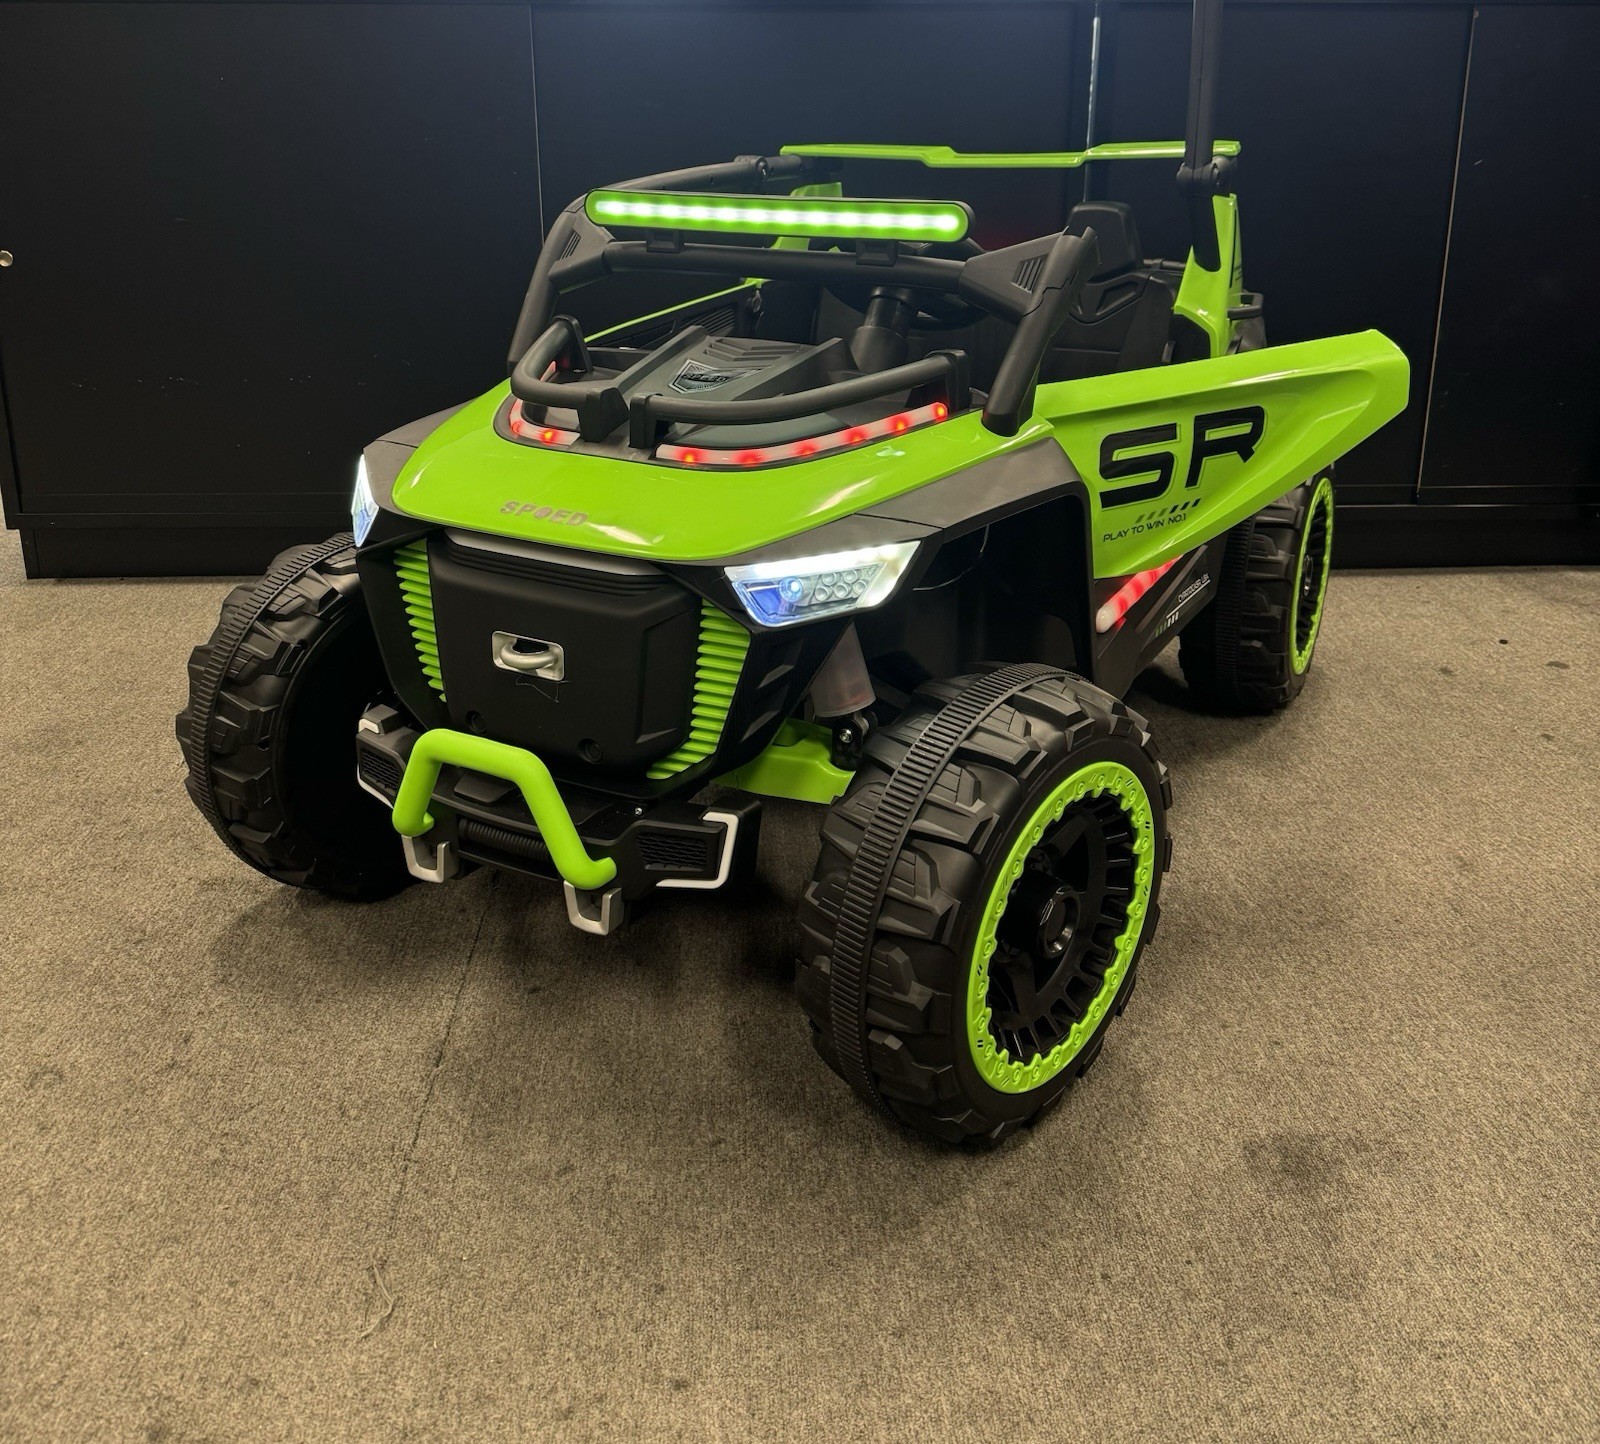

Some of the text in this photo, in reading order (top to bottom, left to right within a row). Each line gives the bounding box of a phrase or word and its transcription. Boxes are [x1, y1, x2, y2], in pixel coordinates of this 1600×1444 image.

[1099, 405, 1266, 508] SR
[1103, 529, 1129, 542] PLAY
[1132, 525, 1144, 534] TO
[1146, 519, 1164, 530] WIN
